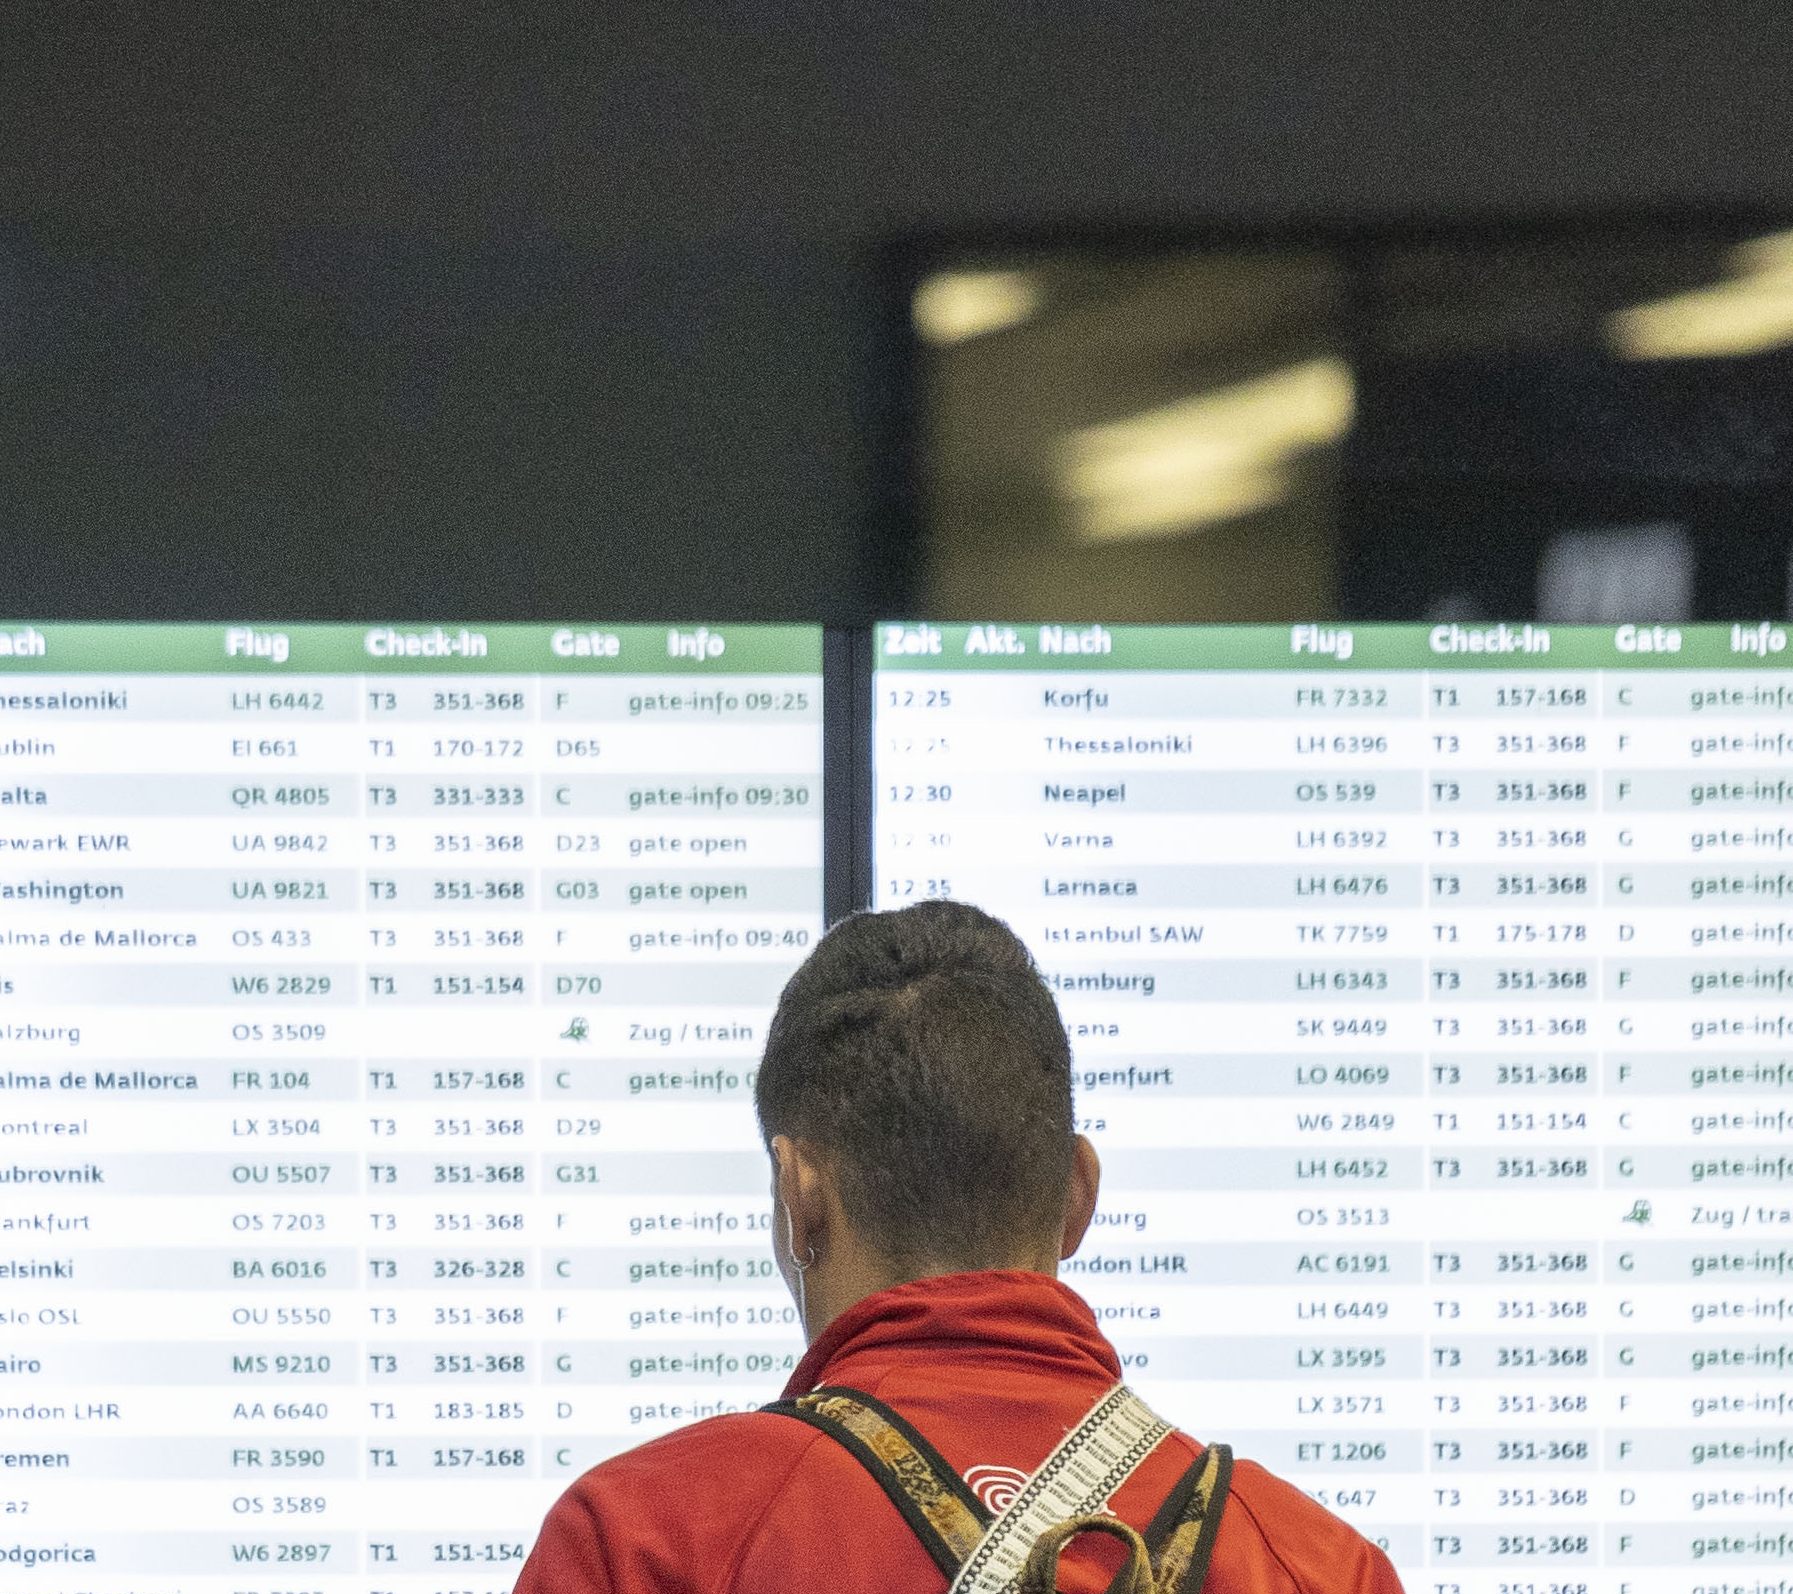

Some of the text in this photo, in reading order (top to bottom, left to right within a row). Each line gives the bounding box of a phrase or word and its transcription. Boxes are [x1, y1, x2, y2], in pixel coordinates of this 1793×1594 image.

[224, 627, 725, 662] Flug Check-In Gate Info
[884, 625, 1787, 660] Zeit Akt. Nach Flug Check-In Gate Info
[231, 690, 809, 717] LH 6442 T3 351-368 F gate-info 09:25
[1043, 686, 1633, 712] Korfu FR 7332 T1 157-168 C
[1044, 733, 1629, 754] Thessaloniki LH 6396 T3 351-368 F
[230, 785, 810, 811] QR 4805 T3 331-333 C gate-info 09:30
[1043, 781, 1631, 808] Neapel OS 539 T3 351-368 F
[231, 880, 748, 906] UA 9821 T3 351-368 G03 gate open
[1043, 878, 1138, 897] Larnaca
[1295, 876, 1327, 896] LH
[1332, 876, 1389, 896] 6476
[1432, 875, 1461, 896] T3
[1497, 875, 1588, 895] 351-368
[230, 975, 603, 995] W6 2829 T1 151-154 D70
[1295, 969, 1631, 991] LH 6343 T3 351-368 F
[231, 1023, 264, 1042] OS
[272, 1023, 327, 1042] 3509
[629, 1023, 673, 1046] Zug
[695, 1022, 754, 1041] train
[58, 1069, 571, 1090] de Mallorca FR 104 T1 157-168 C
[1296, 1063, 1631, 1086] LO 4069 T3 351-368 F
[230, 1164, 600, 1184] OU 5507 T3 351-368 G31
[231, 1258, 571, 1279] BA 6016 T3 326-328 C
[1296, 1253, 1329, 1274] AC
[1334, 1254, 1390, 1274] 6191
[1432, 1253, 1462, 1273] T3
[1497, 1253, 1588, 1273] 351-368
[231, 1353, 573, 1374] MS 9210 T3 351-368 G
[231, 1448, 572, 1470] FR 3590 T1 157-168 C
[1297, 1440, 1632, 1462] ET 1206 T3 351-368 F
[231, 1543, 525, 1563] W6 2897 T1 151-154
